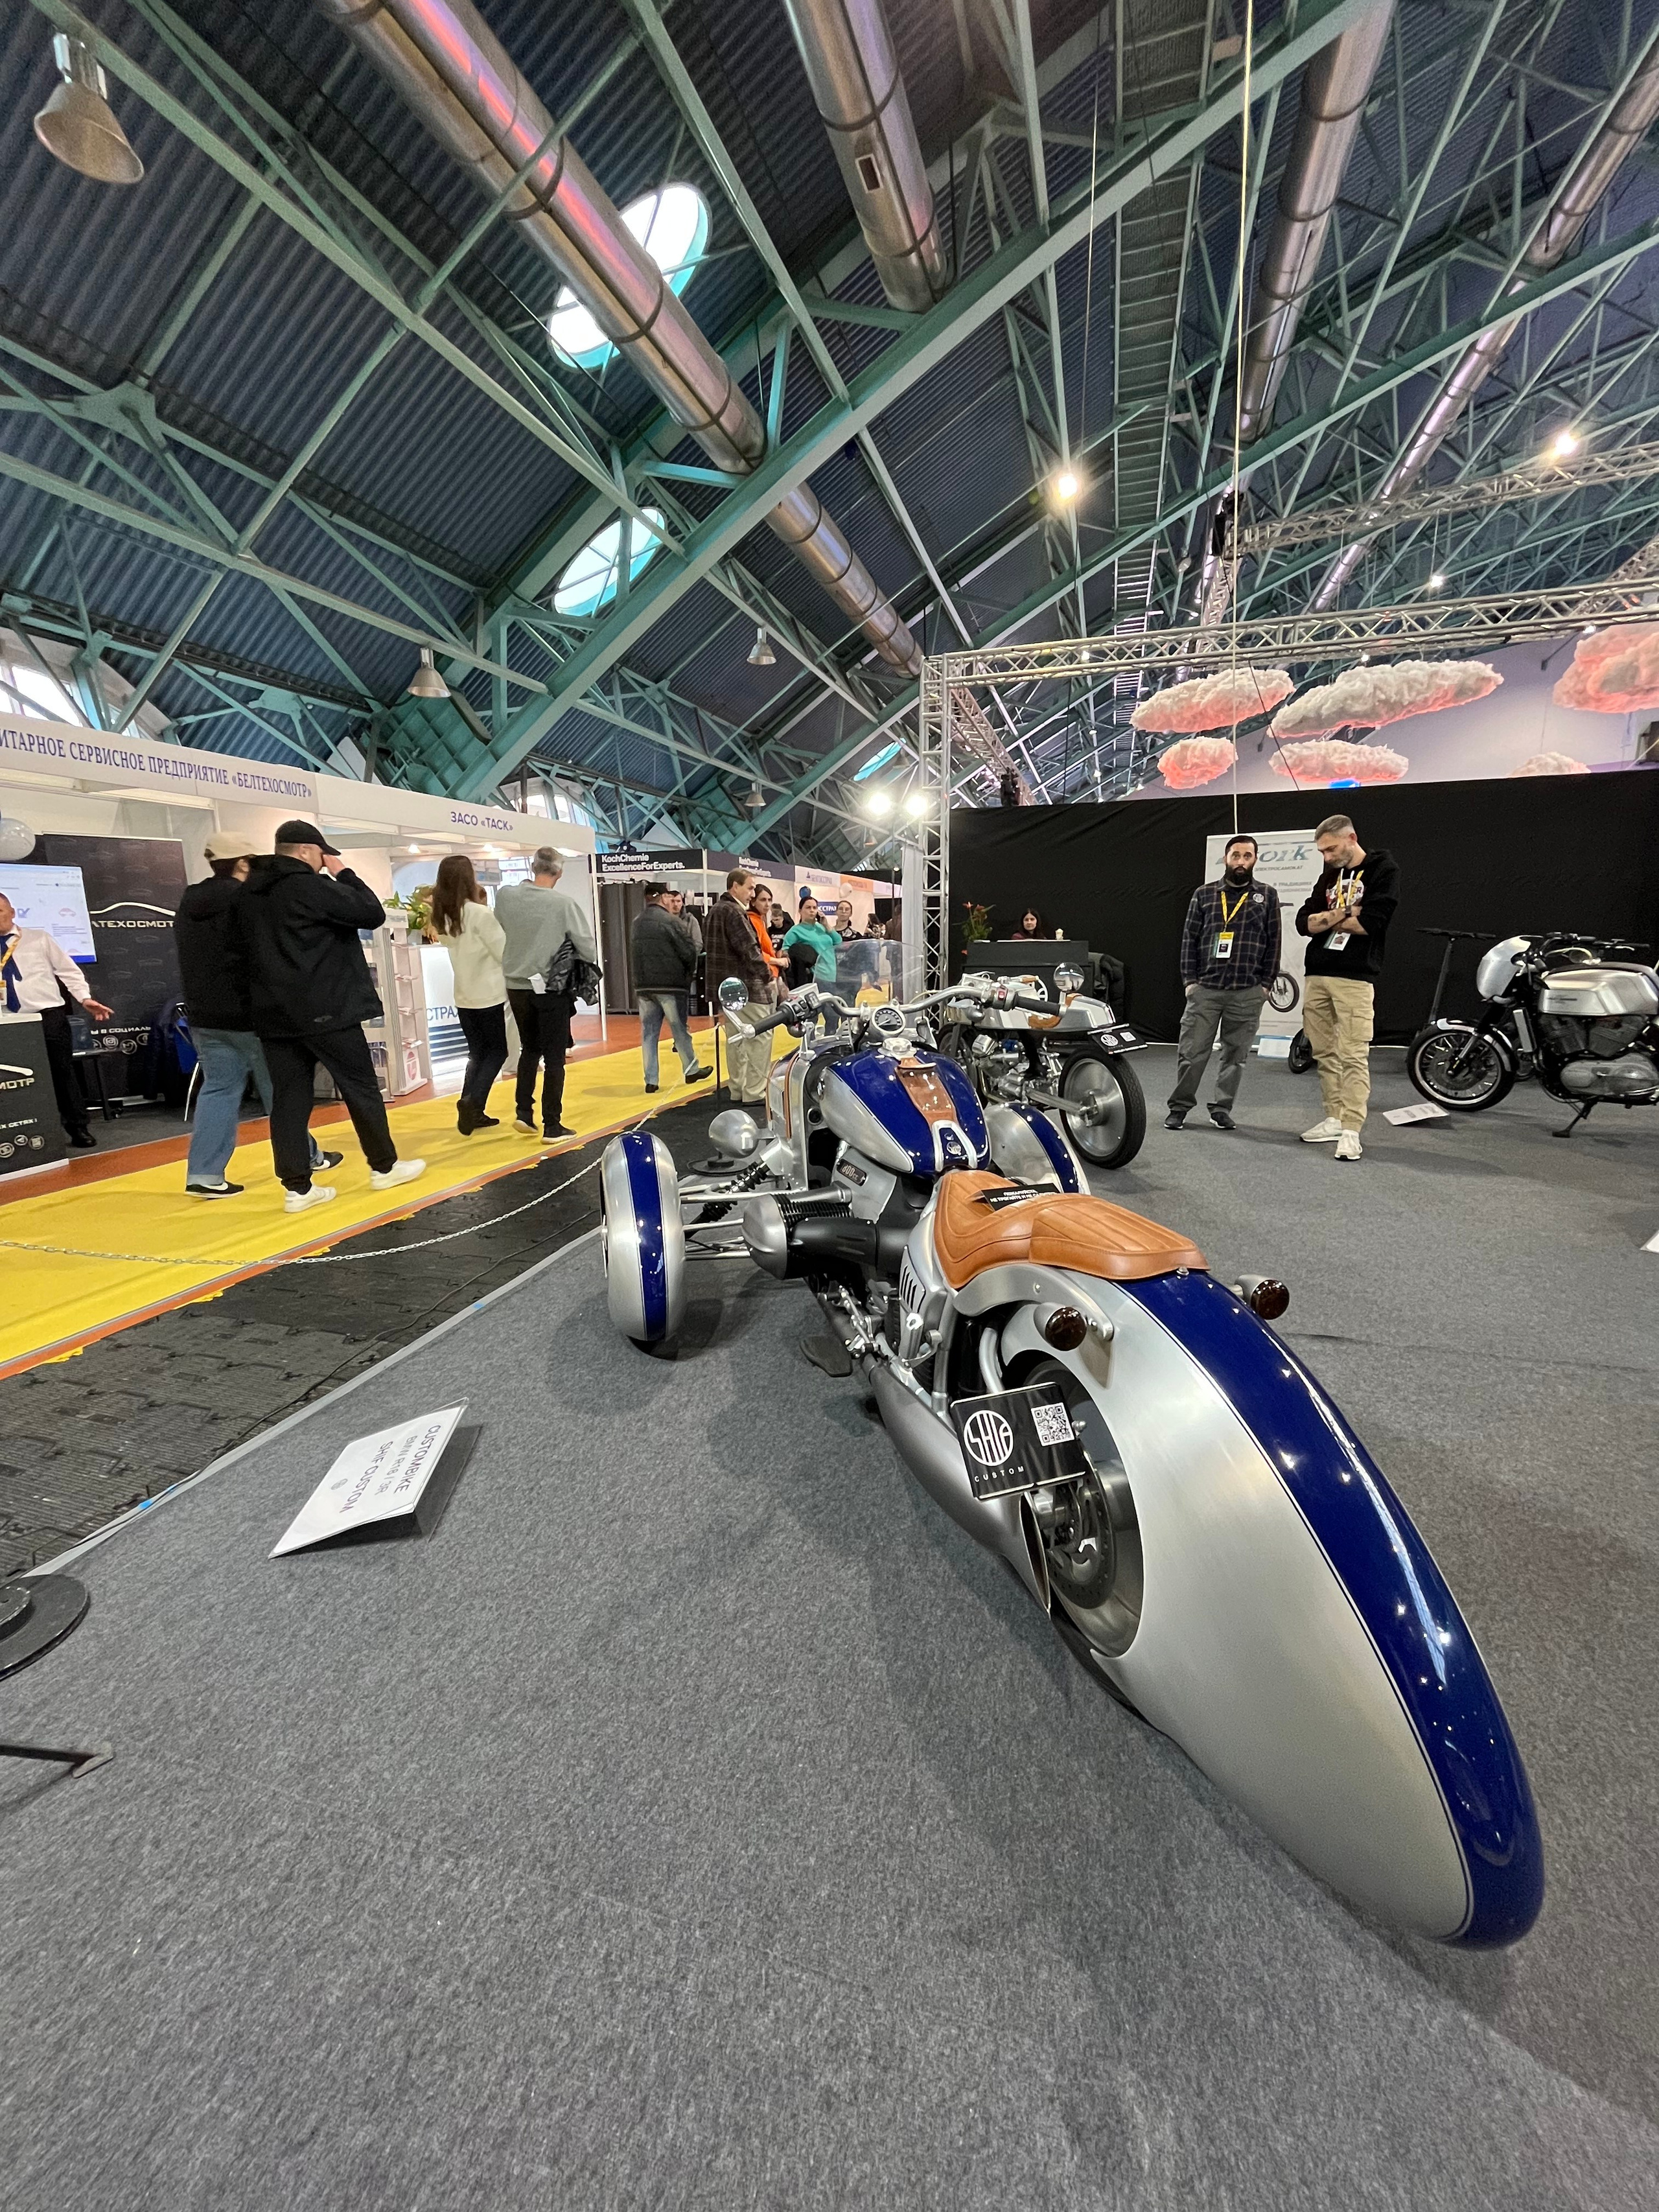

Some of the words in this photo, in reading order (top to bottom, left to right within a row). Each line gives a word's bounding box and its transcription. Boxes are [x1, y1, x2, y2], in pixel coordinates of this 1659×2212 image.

[0, 728, 66, 758] ИТАРНОЕ
[69, 741, 146, 771] СЕРВИСНОЕ
[148, 756, 229, 785] ПРЕДПРИЯТИЕ
[232, 772, 312, 798] «БЕЛТЕХОСМОТР»
[450, 811, 478, 827] ЗАСО
[481, 817, 514, 832] «ТАСК»
[601, 853, 649, 863] KochChemie
[602, 861, 686, 872] ExcellenceForExperts.
[371, 1440, 393, 1463] SHIF
[397, 1435, 417, 1456] BMW
[386, 1457, 405, 1476] R18
[394, 1425, 441, 1495] CUSTOMBIKE
[974, 1465, 1025, 1482] CUSTOM
[339, 1465, 378, 1513] CUSTOM
